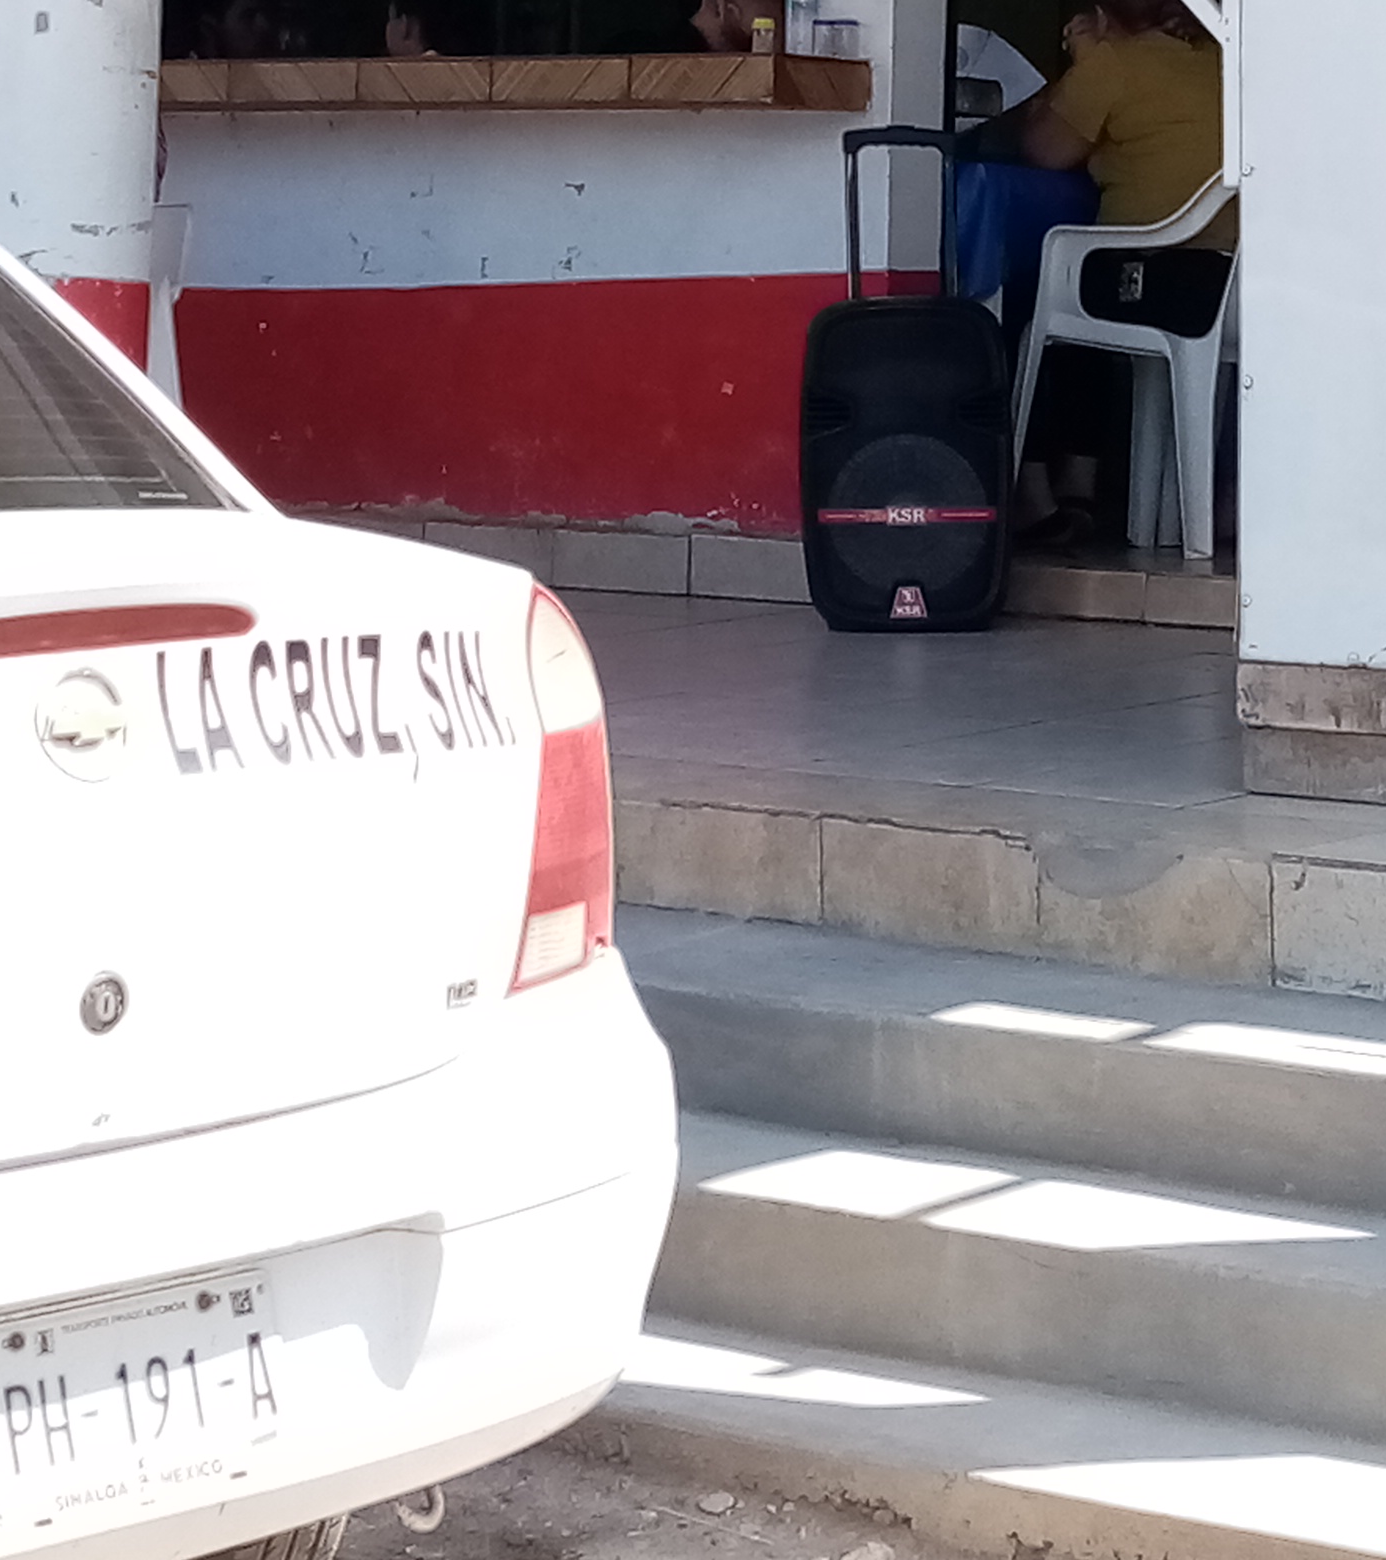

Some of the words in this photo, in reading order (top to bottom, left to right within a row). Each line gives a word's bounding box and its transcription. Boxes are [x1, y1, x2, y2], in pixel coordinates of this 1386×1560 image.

[887, 508, 927, 523] KSR
[156, 646, 245, 775] LA
[55, 1482, 129, 1512] SINALOA
